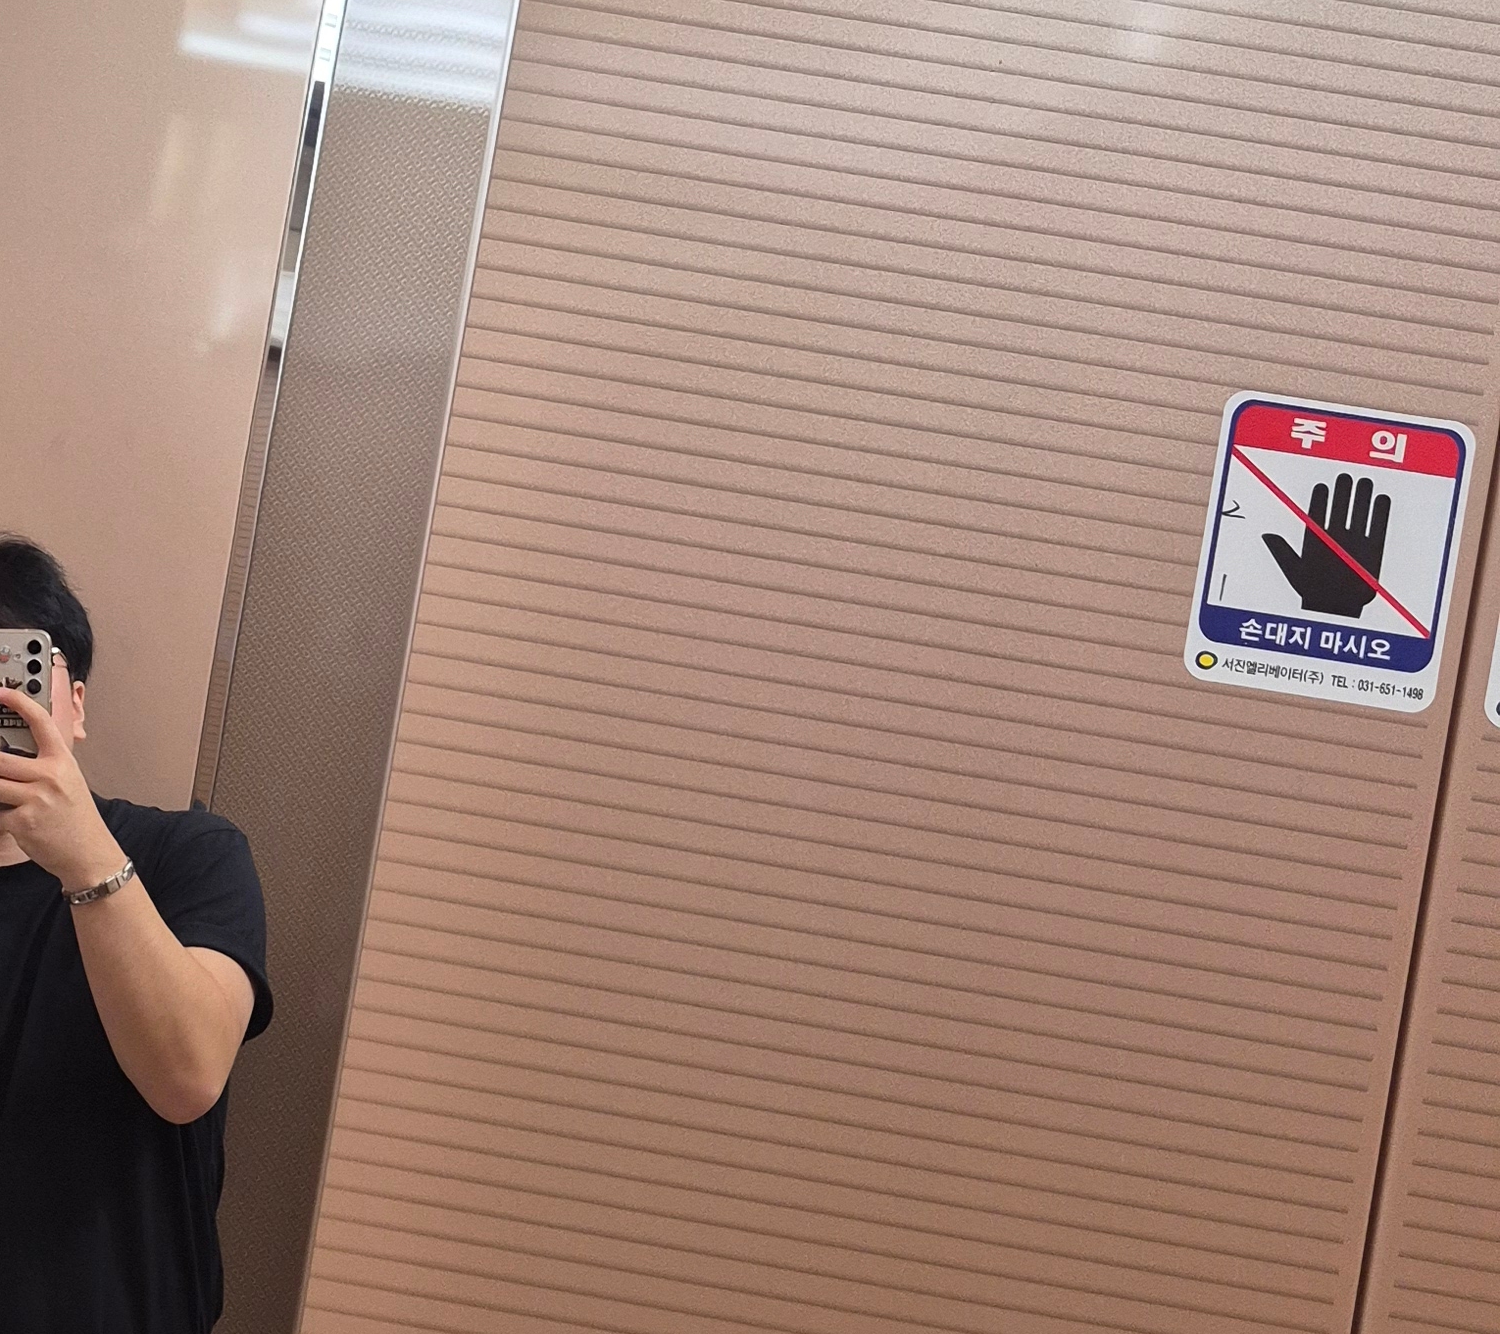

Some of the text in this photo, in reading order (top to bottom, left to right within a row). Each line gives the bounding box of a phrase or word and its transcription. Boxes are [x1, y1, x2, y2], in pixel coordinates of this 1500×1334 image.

[1239, 618, 1391, 661] 손대지 마시오
[1357, 679, 1424, 701] 031-651-1498
